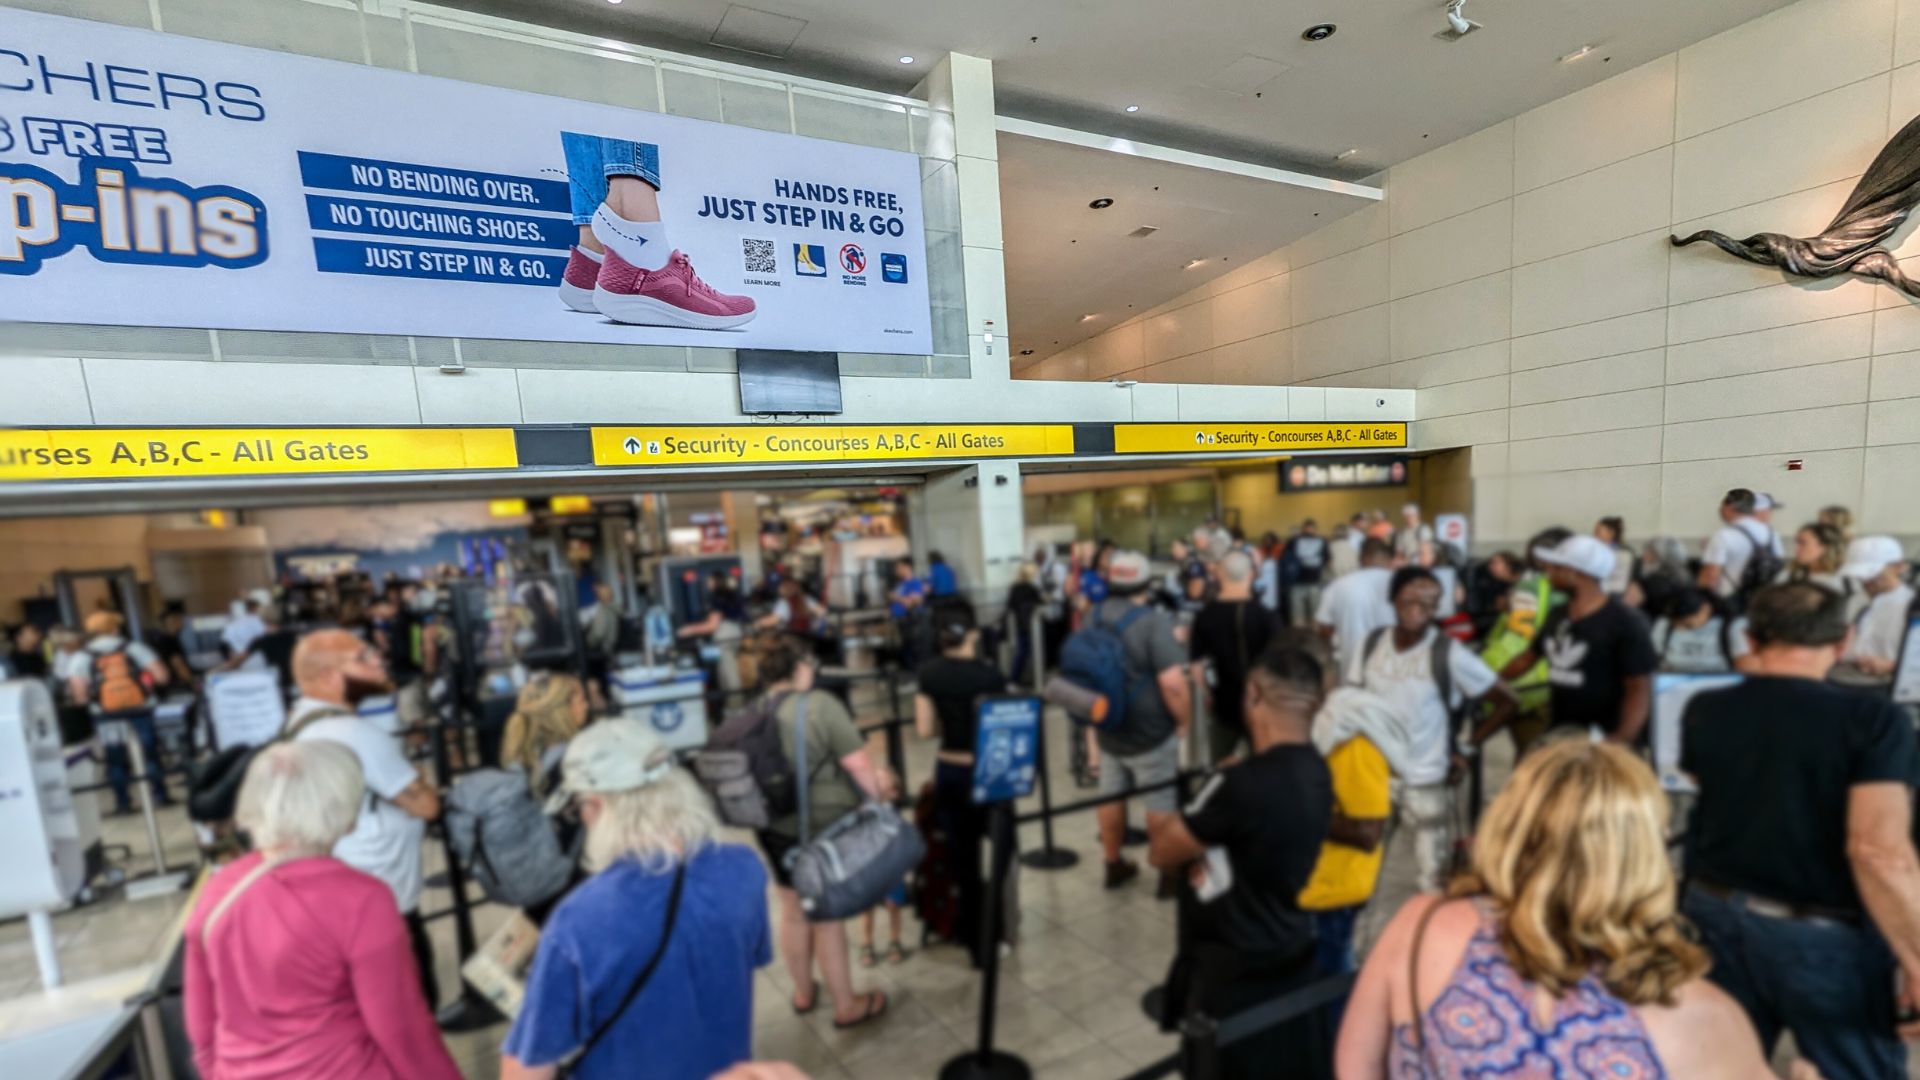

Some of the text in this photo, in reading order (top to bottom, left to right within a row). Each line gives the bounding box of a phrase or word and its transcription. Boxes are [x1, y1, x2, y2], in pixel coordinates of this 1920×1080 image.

[22, 116, 172, 165] FREE
[351, 164, 540, 204] NO BENDING OVER.
[774, 178, 903, 215] HANDS FREE,
[330, 203, 546, 242] NO TOUCHING SHOES.
[698, 196, 904, 238] JUST STEP IN & GO
[365, 247, 551, 280] JUST STEP IN & GO.
[743, 278, 763, 286] LEARN
[111, 440, 204, 467] A,B,C
[232, 439, 274, 462] All
[284, 439, 370, 462] Gates
[664, 433, 747, 458] Security
[766, 435, 869, 452] Concourses
[876, 433, 921, 452] A,B,C
[936, 432, 957, 449] All
[961, 433, 1004, 449] Gates
[1216, 431, 1259, 446] Security
[1268, 429, 1323, 443] Concourses
[1326, 429, 1352, 443] A,B,C
[1359, 428, 1371, 441] All
[1373, 429, 1398, 441] Gates
